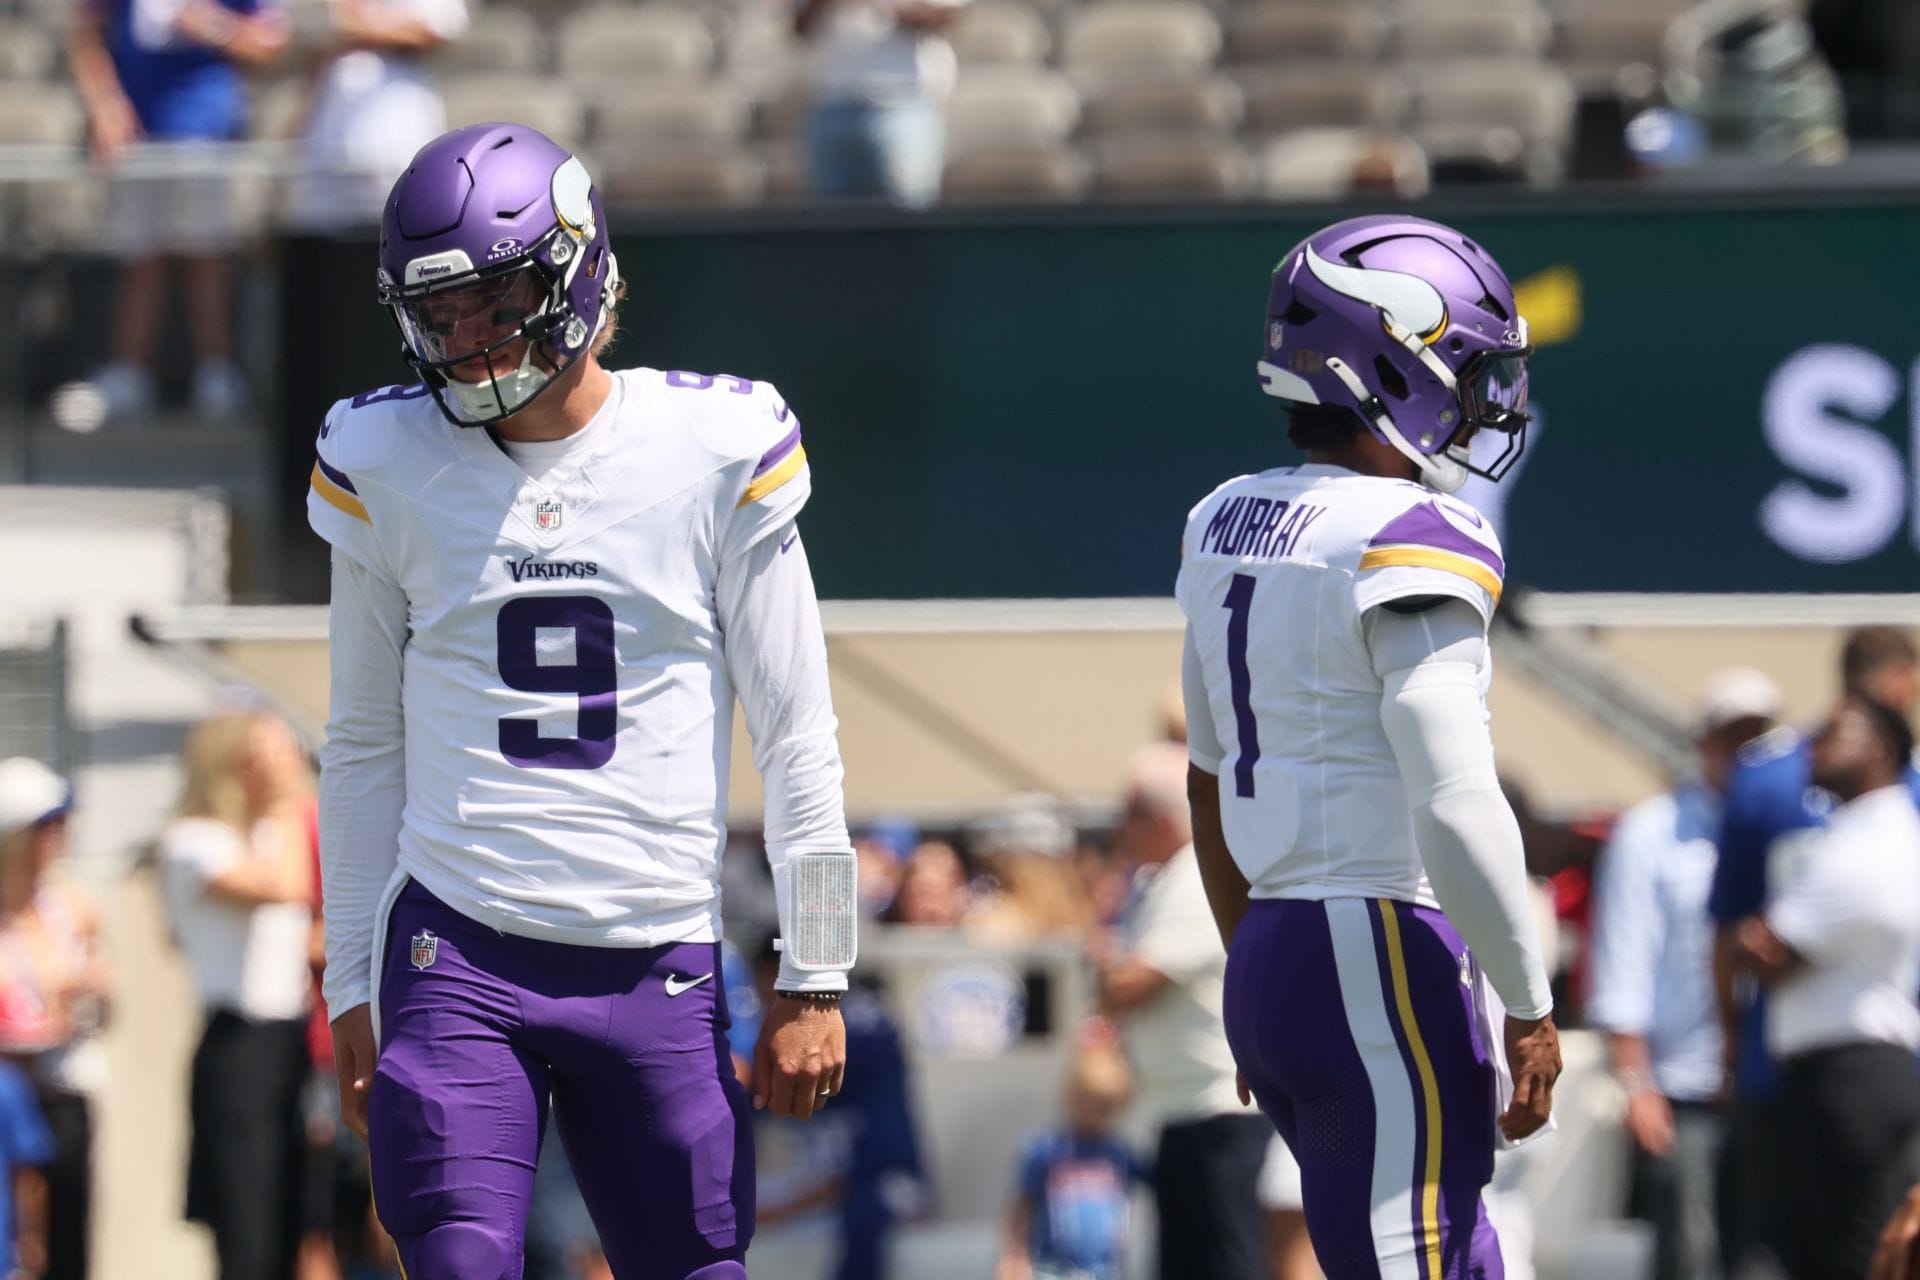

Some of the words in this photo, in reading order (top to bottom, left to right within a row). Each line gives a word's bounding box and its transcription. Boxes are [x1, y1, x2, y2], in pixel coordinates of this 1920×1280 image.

[1200, 496, 1328, 558] MURRAY
[1758, 342, 1920, 564] S
[497, 595, 617, 770] 9
[1222, 573, 1261, 799] 1
